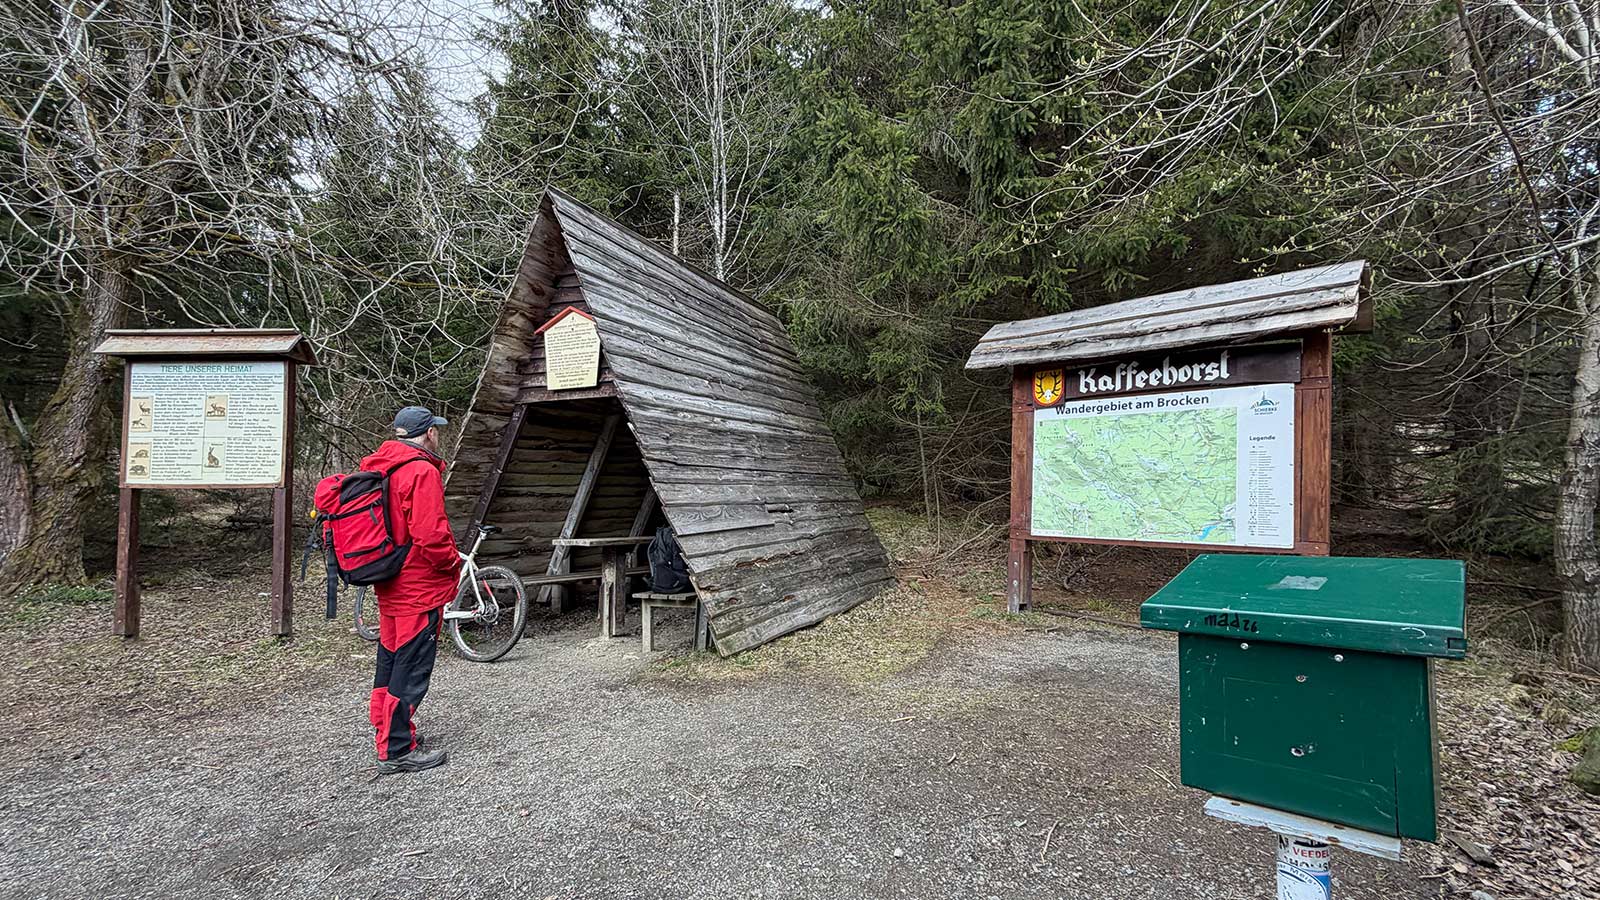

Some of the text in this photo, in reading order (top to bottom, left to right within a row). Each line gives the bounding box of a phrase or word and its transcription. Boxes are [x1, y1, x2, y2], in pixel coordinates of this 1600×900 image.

[160, 365, 254, 373] TIERE UNSERER HEIMAT
[1078, 350, 1231, 394] Kaffeehorst
[1055, 395, 1210, 416] Wandergebiet am Brocken
